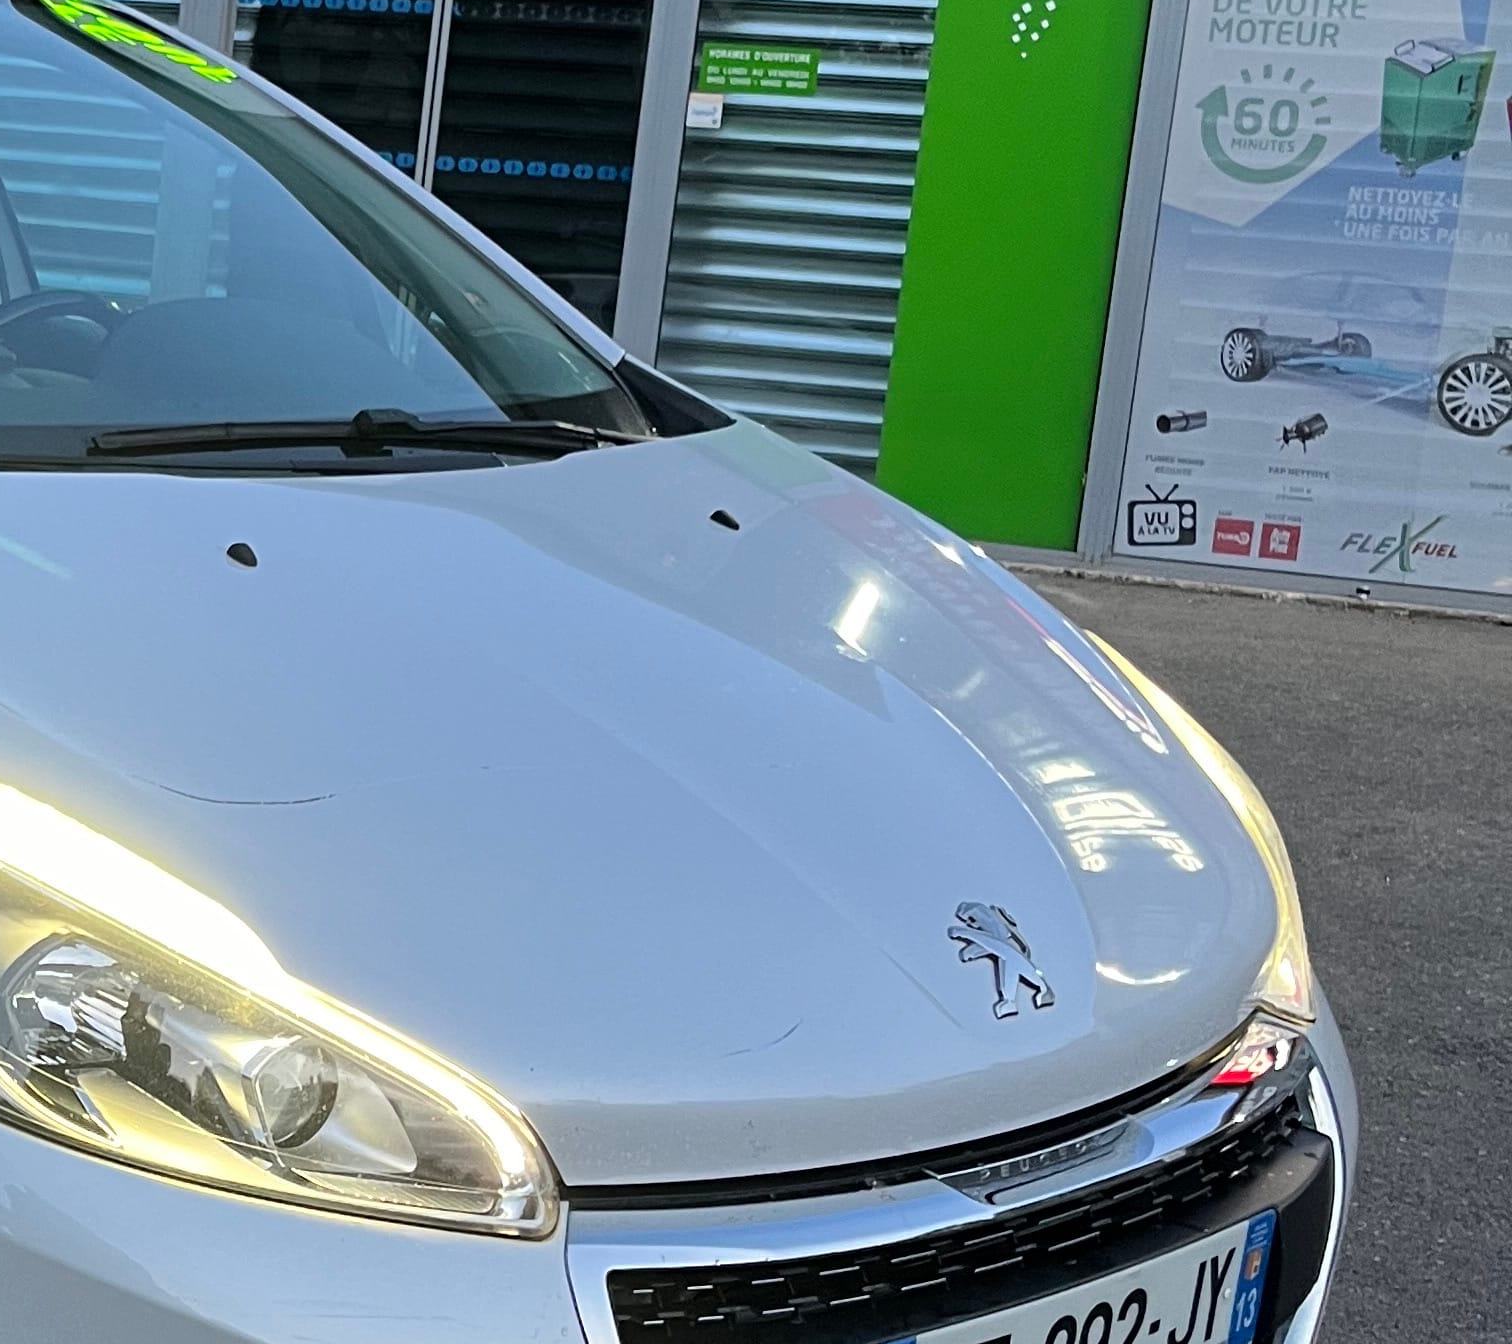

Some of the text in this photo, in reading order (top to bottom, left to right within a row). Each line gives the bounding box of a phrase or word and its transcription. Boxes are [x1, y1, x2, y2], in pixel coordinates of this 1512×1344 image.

[1208, 17, 1340, 48] MOTEUR
[1233, 97, 1300, 139] 60
[1230, 137, 1296, 154] MINUTES
[1345, 203, 1441, 225] AU MOINS
[1343, 220, 1384, 240] UNE
[1387, 225, 1432, 243] FOIS
[1144, 511, 1170, 526] VU
[1148, 525, 1160, 536] LA
[1162, 526, 1176, 536] TV
[1235, 1287, 1257, 1332] 13
